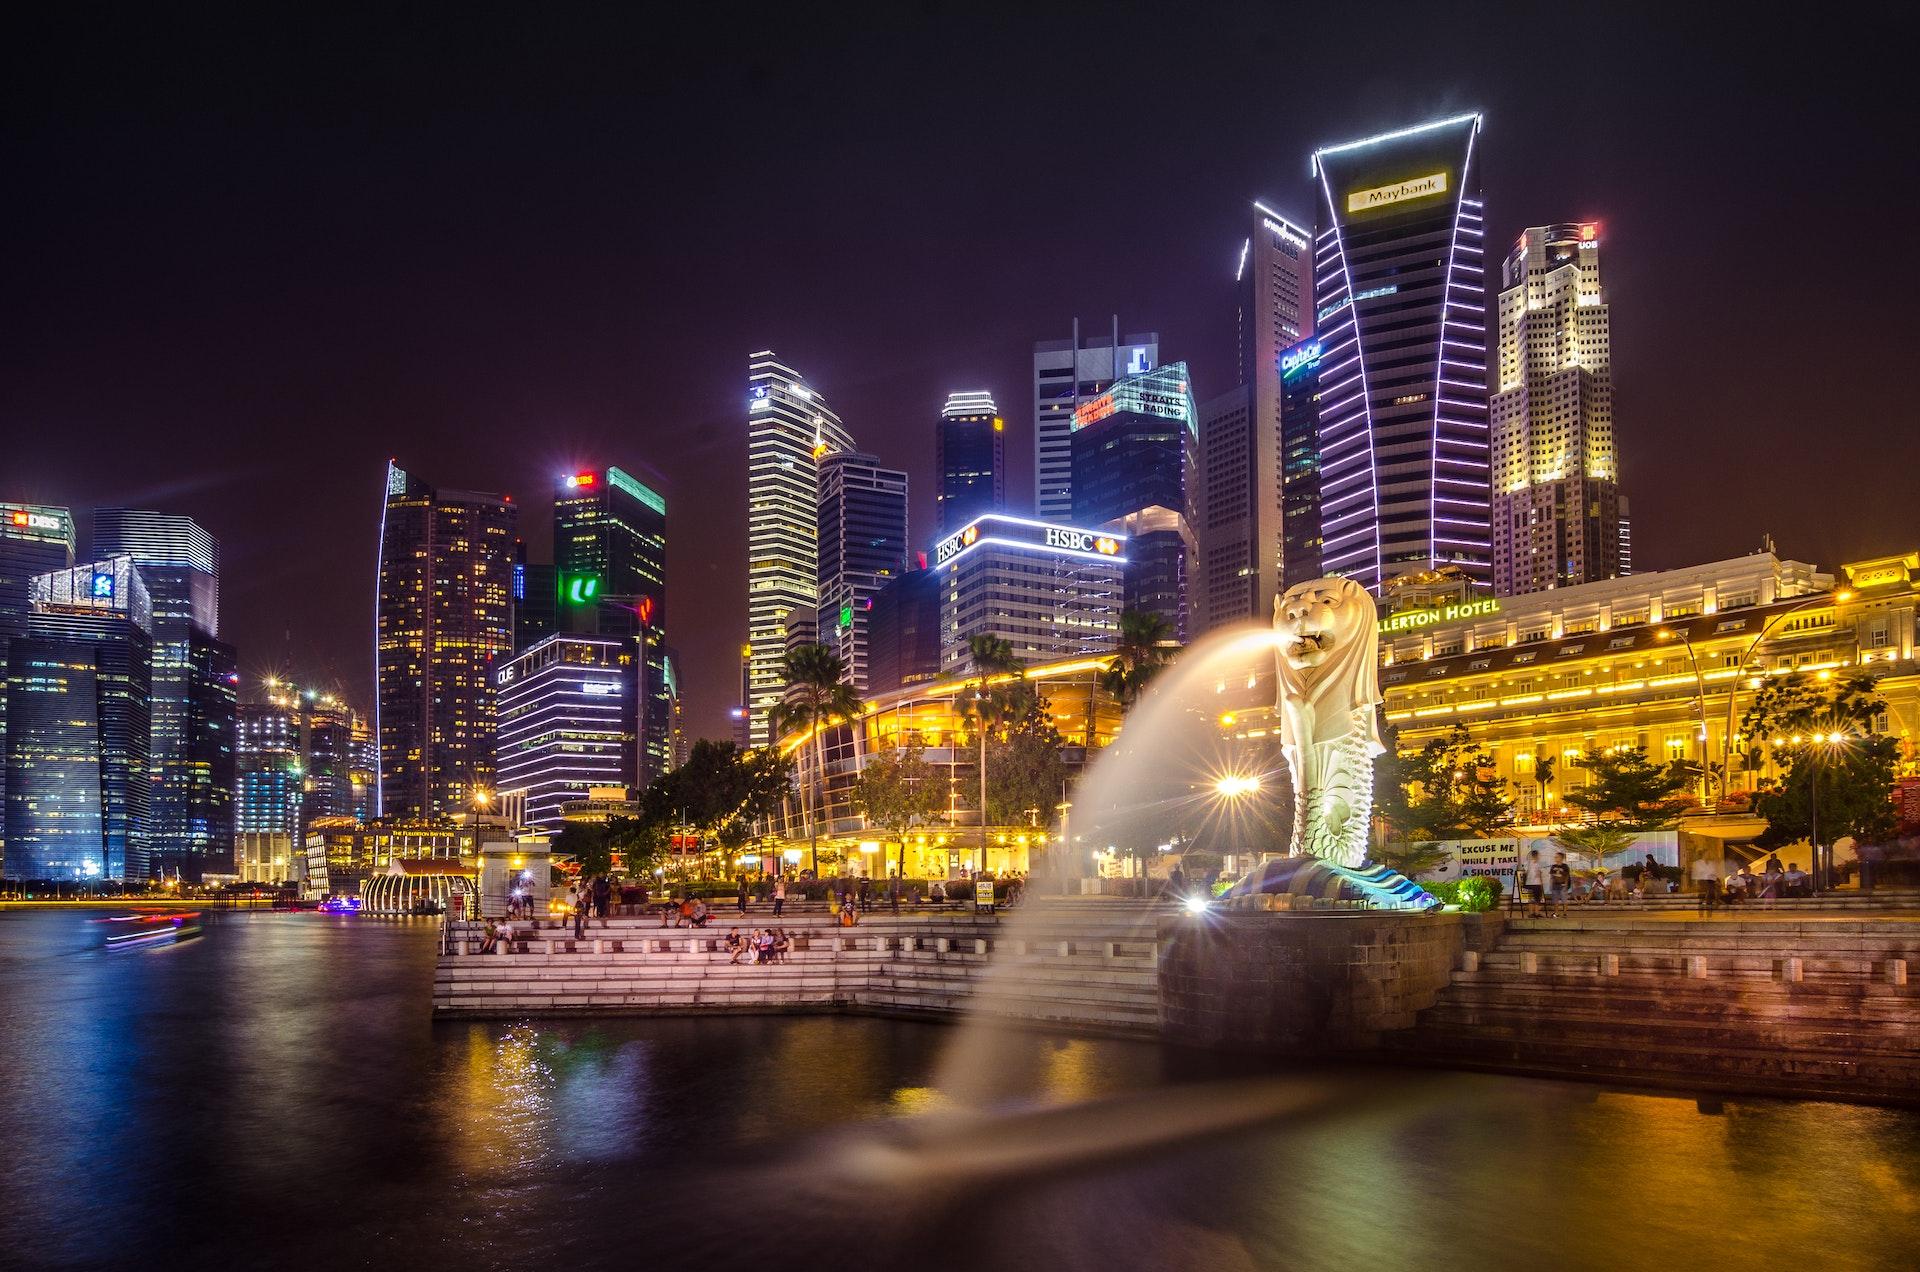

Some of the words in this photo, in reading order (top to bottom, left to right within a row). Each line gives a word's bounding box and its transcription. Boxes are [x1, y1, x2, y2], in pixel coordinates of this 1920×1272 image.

[1369, 180, 1436, 203] Maybank
[1579, 240, 1598, 249] UOB
[1139, 393, 1181, 406] STRAITS
[1136, 402, 1181, 416] TRADING
[28, 514, 60, 529] DBS
[1046, 528, 1093, 551] HSBC
[937, 533, 964, 563] HSBC
[1446, 599, 1500, 619] HOTEL
[1500, 844, 1514, 852] ME
[1490, 857, 1495, 866] I
[1497, 857, 1518, 865] TAKE
[1462, 868, 1469, 877] A
